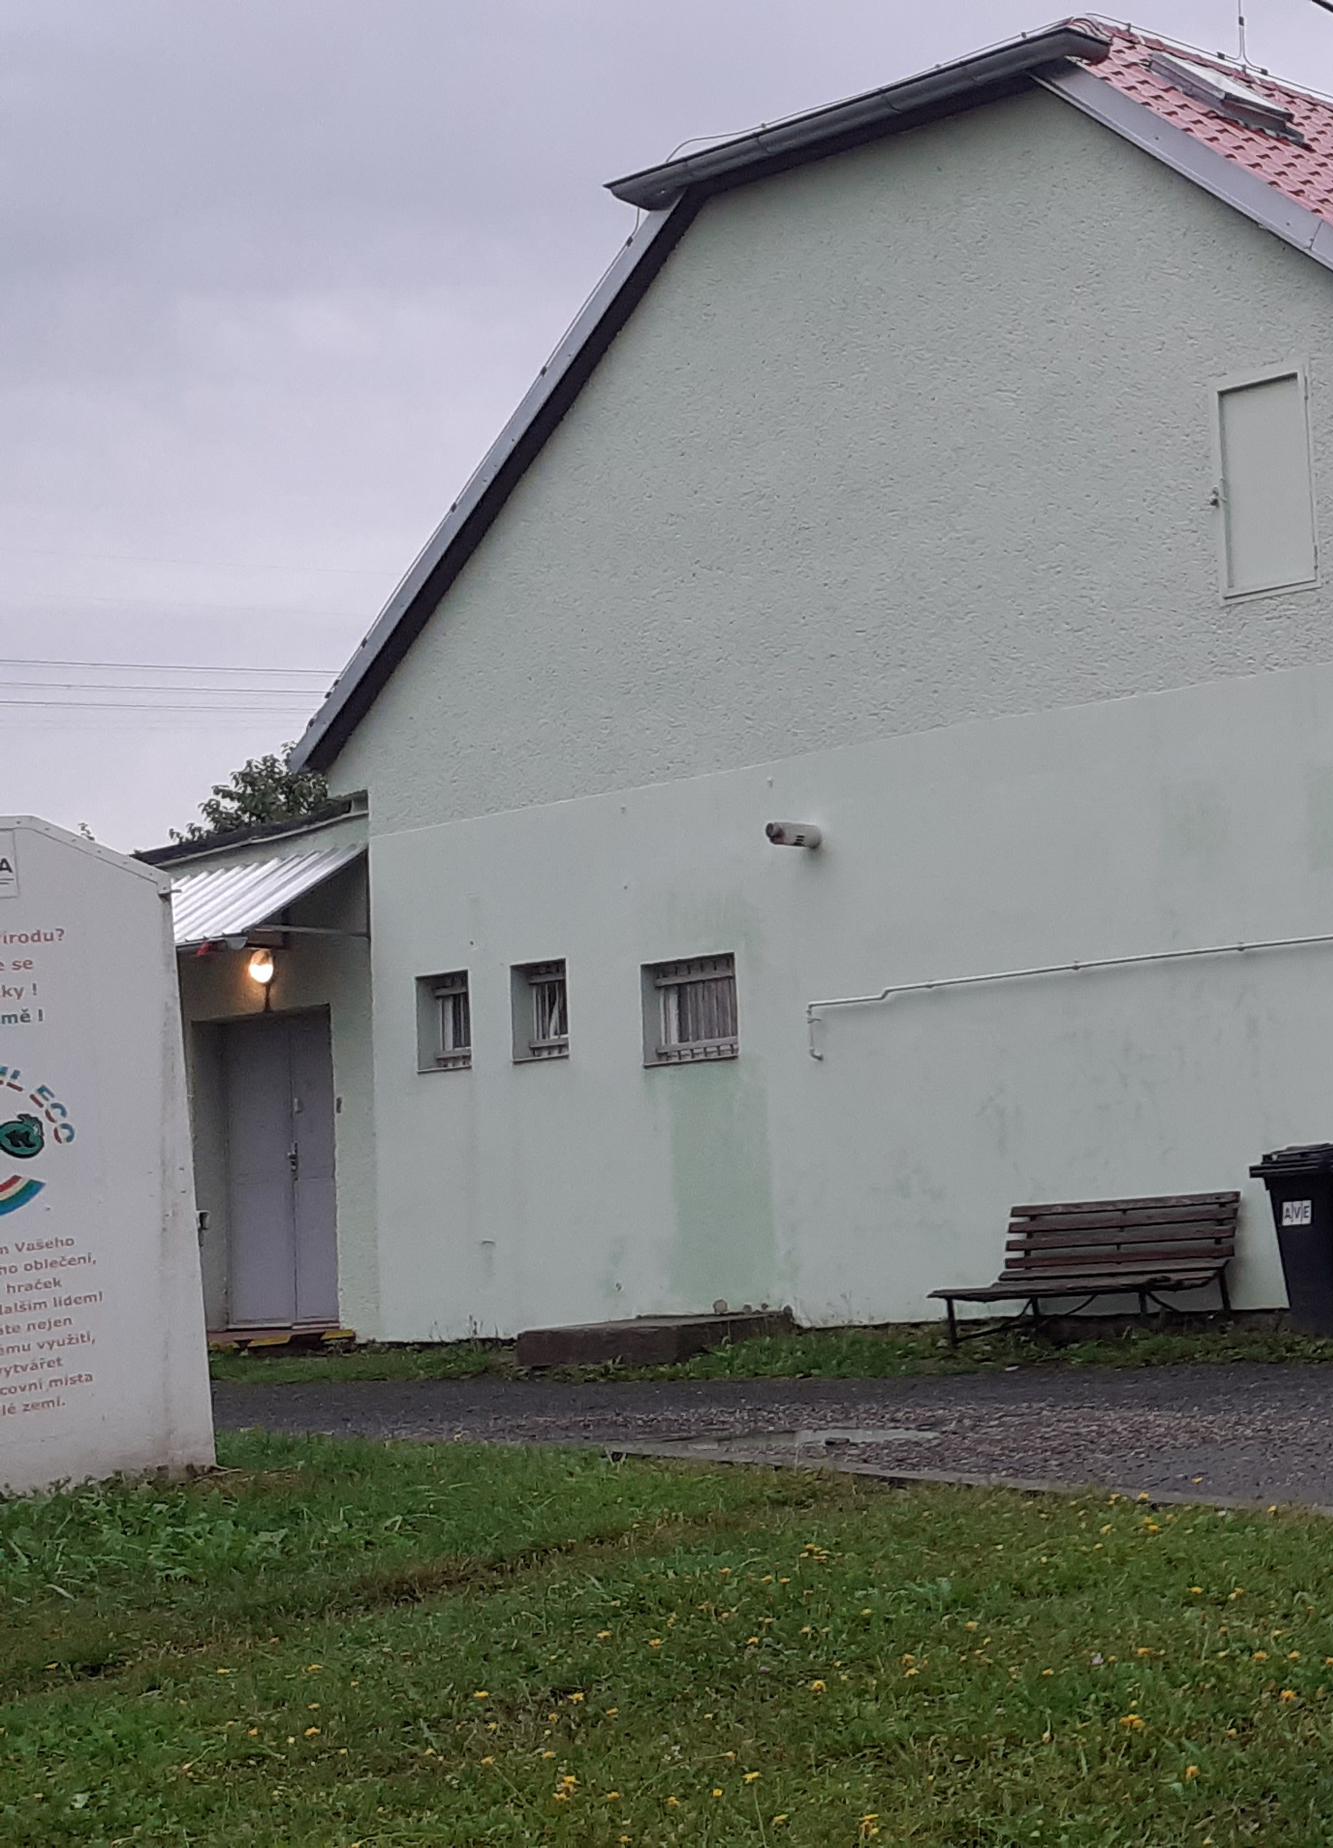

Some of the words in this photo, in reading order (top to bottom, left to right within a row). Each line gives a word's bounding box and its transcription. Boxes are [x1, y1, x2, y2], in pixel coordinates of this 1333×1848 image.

[12, 959, 34, 971] se
[32, 982, 38, 996] !
[29, 1084, 75, 1145] ECO
[6, 1277, 62, 1294] hraček
[0, 1300, 47, 1315] alším
[27, 1317, 72, 1331] nejen
